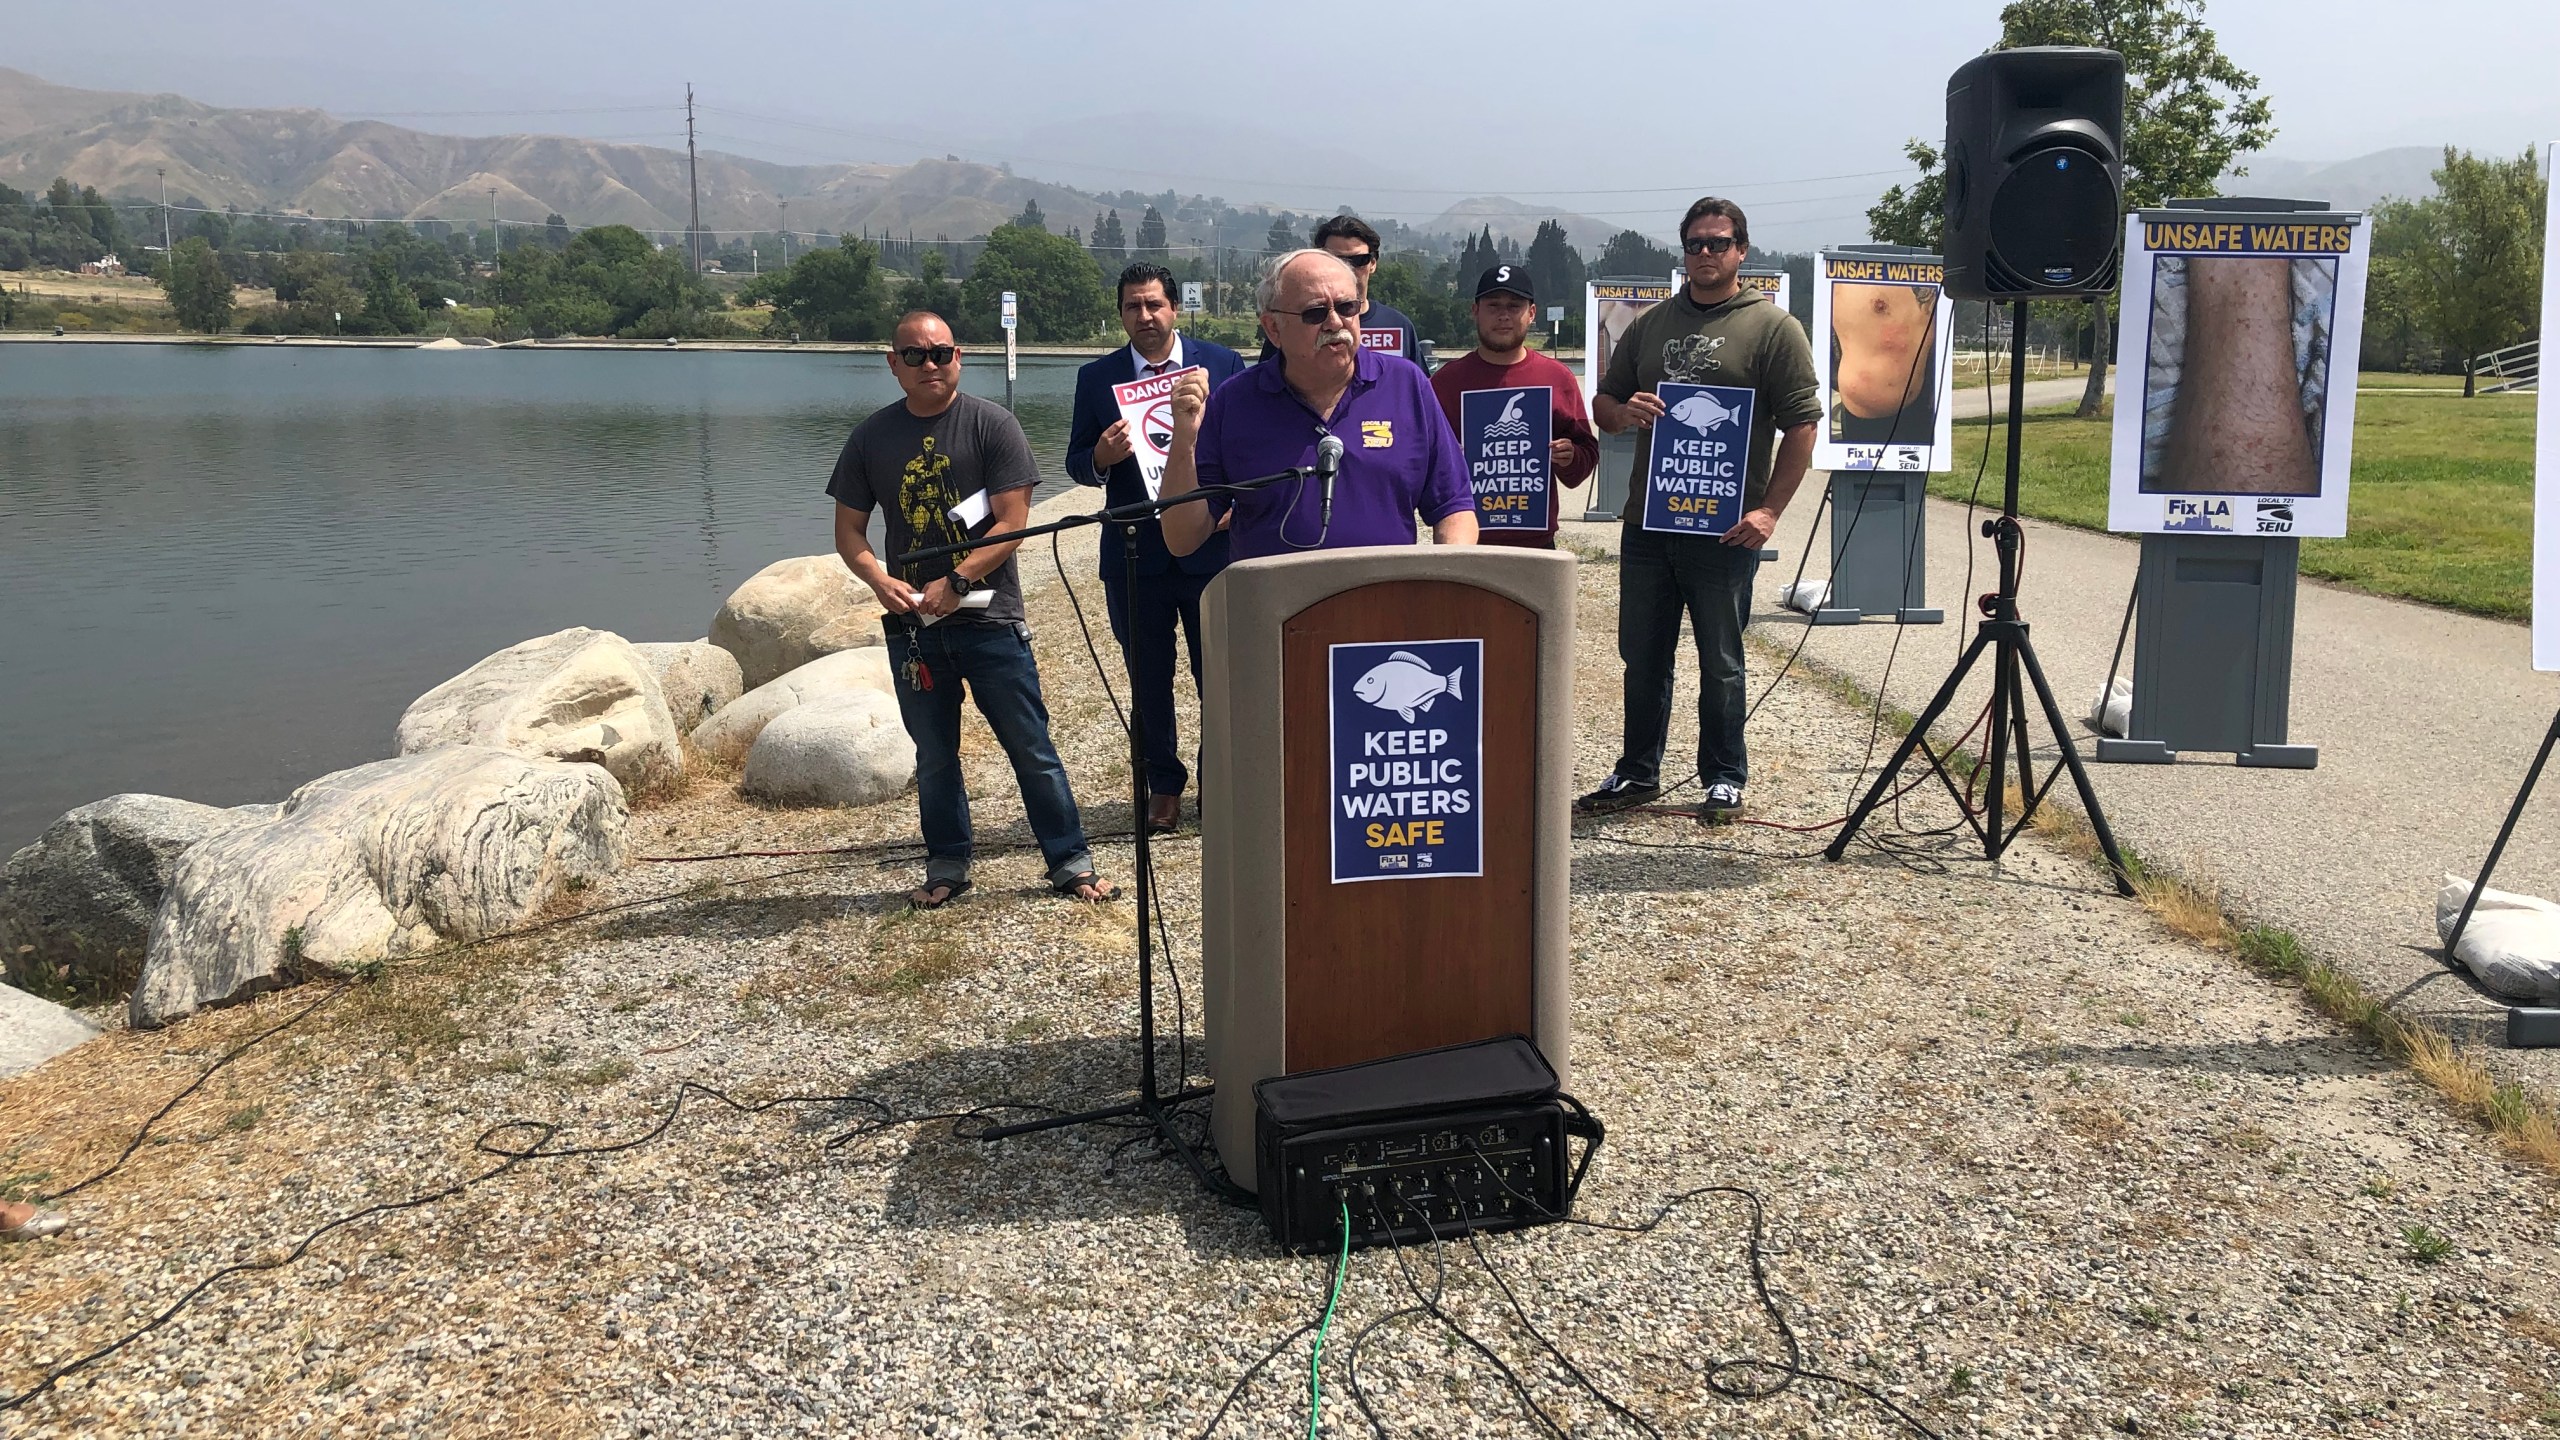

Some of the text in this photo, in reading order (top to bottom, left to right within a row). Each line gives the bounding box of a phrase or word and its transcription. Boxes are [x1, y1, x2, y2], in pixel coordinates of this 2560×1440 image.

[2147, 224, 2350, 251] UNSAFE WATERS
[1496, 265, 1511, 282] S
[1826, 260, 1944, 283] UNSAFE WATERS
[1595, 286, 1671, 299] UNSAFE WATER
[1740, 276, 1780, 291] ERS
[1360, 333, 1394, 347] GER
[1122, 374, 1186, 402] DANG
[1482, 440, 1532, 458] KEEP
[1672, 438, 1727, 457] KEEP
[1847, 447, 1883, 459] Fix LA
[1473, 458, 1541, 477] PUBLIC
[1661, 457, 1735, 478] PUBLIC
[1899, 462, 1919, 470] SEIU
[1470, 477, 1544, 494] WATERS
[1655, 475, 1738, 497] WATERS
[1482, 495, 1529, 511] SAFE
[1667, 496, 1719, 515] SAFE
[2168, 499, 2230, 516] Fix LA
[2256, 522, 2293, 533] SEIU
[1364, 729, 1448, 757] KEEP
[1349, 758, 1463, 788] PUBLIC
[1341, 788, 1471, 819] WATERS
[1365, 820, 1445, 848] SAFE
